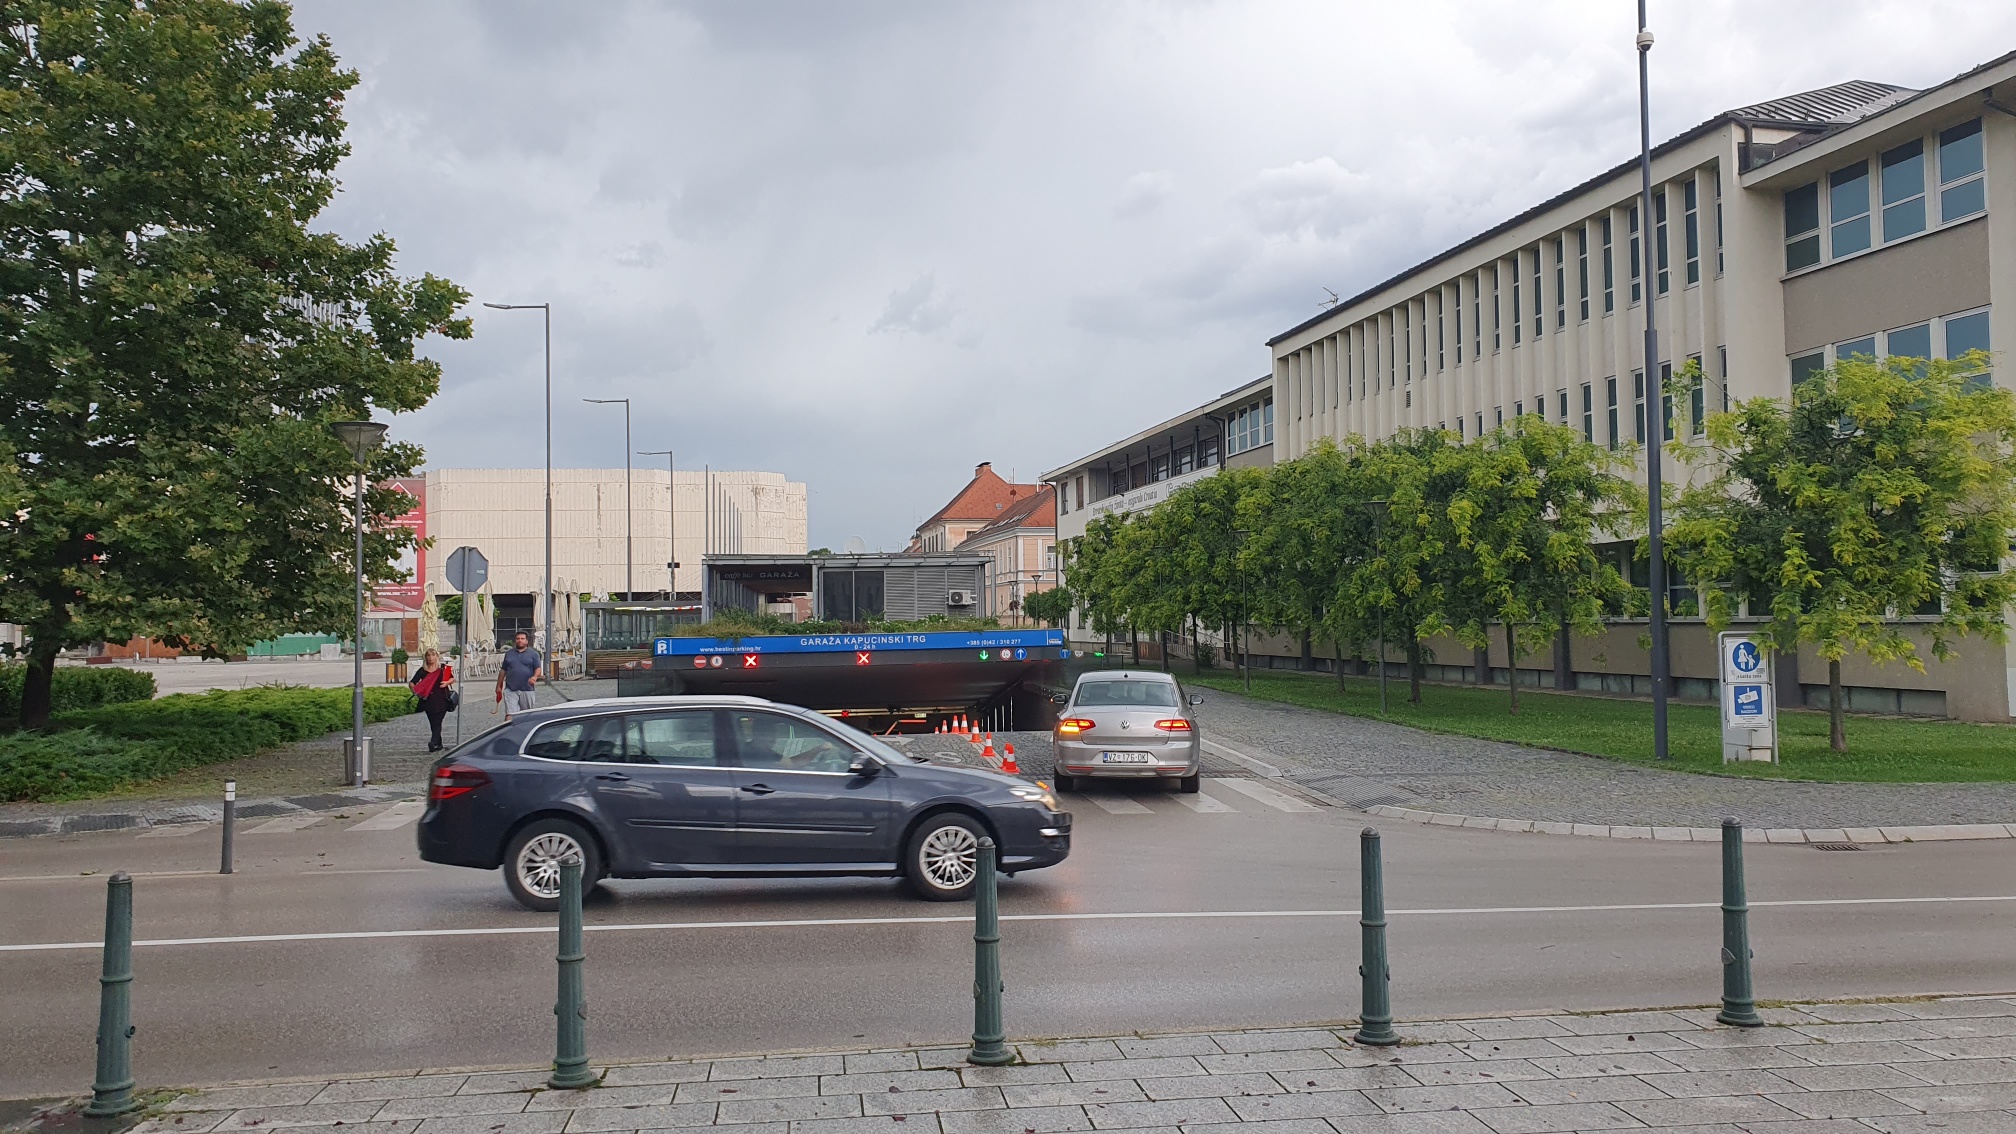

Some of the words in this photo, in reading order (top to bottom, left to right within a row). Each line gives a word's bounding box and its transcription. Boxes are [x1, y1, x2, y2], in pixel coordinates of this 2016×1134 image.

[800, 636, 841, 646] GARAŽA
[844, 635, 904, 645] KAPUCINSKI
[906, 635, 926, 643] TRG
[1108, 753, 1117, 761] VZ
